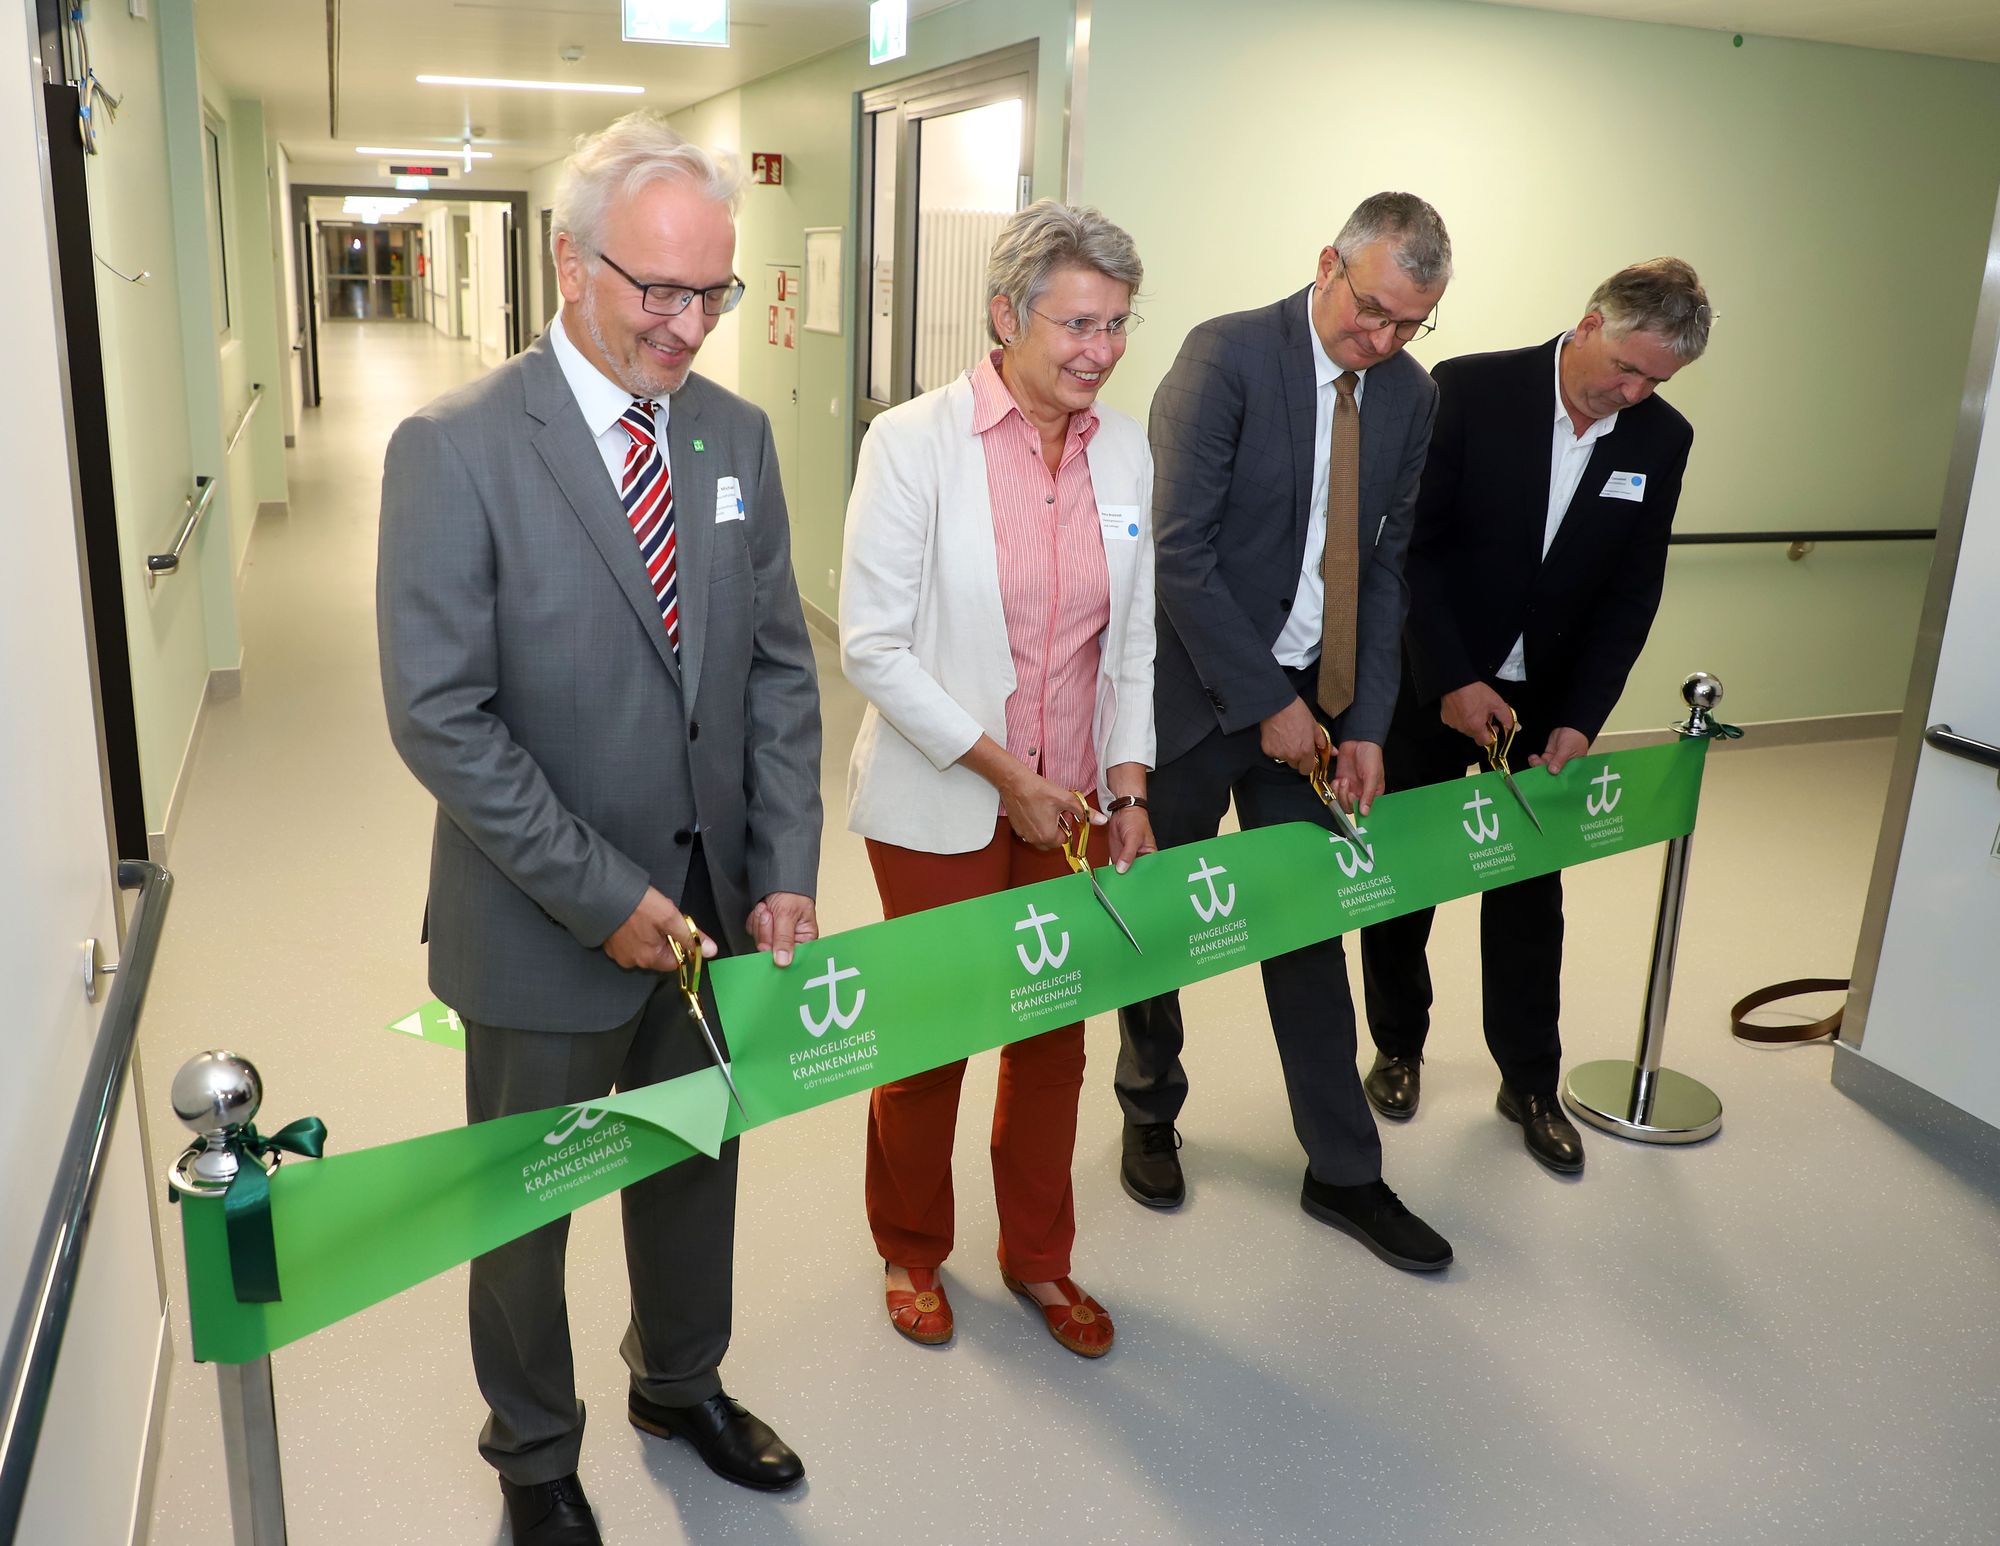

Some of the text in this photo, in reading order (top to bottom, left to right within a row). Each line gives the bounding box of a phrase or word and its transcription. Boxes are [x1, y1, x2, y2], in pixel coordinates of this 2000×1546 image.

[1580, 815, 1623, 832] EVANGELISCHES
[1583, 825, 1624, 841] KRANKENHAUS
[1468, 842, 1514, 861] EVANGELISCHES
[1472, 853, 1516, 871] KRANKENHAUS
[1337, 875, 1392, 898] EVANGELISCHES
[1340, 886, 1396, 909] KRANKENHAUS
[1189, 918, 1247, 944] EVANGELISCHES
[1190, 931, 1249, 957] KRANKENHAUS
[1010, 970, 1082, 999] EVANGELISCHES
[1011, 984, 1082, 1013] KRANKENHAUS
[1018, 999, 1077, 1022] GÖTTINGEN-WEENDE
[789, 1030, 876, 1065] EVANGELISCHES
[792, 1045, 878, 1081] KRANKENHAUS
[803, 1063, 874, 1090] GÖTTINGEN-WEENDE
[522, 1120, 627, 1177] EVANGELISCHES
[524, 1136, 632, 1194] KRANKENHAUS
[539, 1156, 629, 1202] GÖTTINGEN-WEENDE
